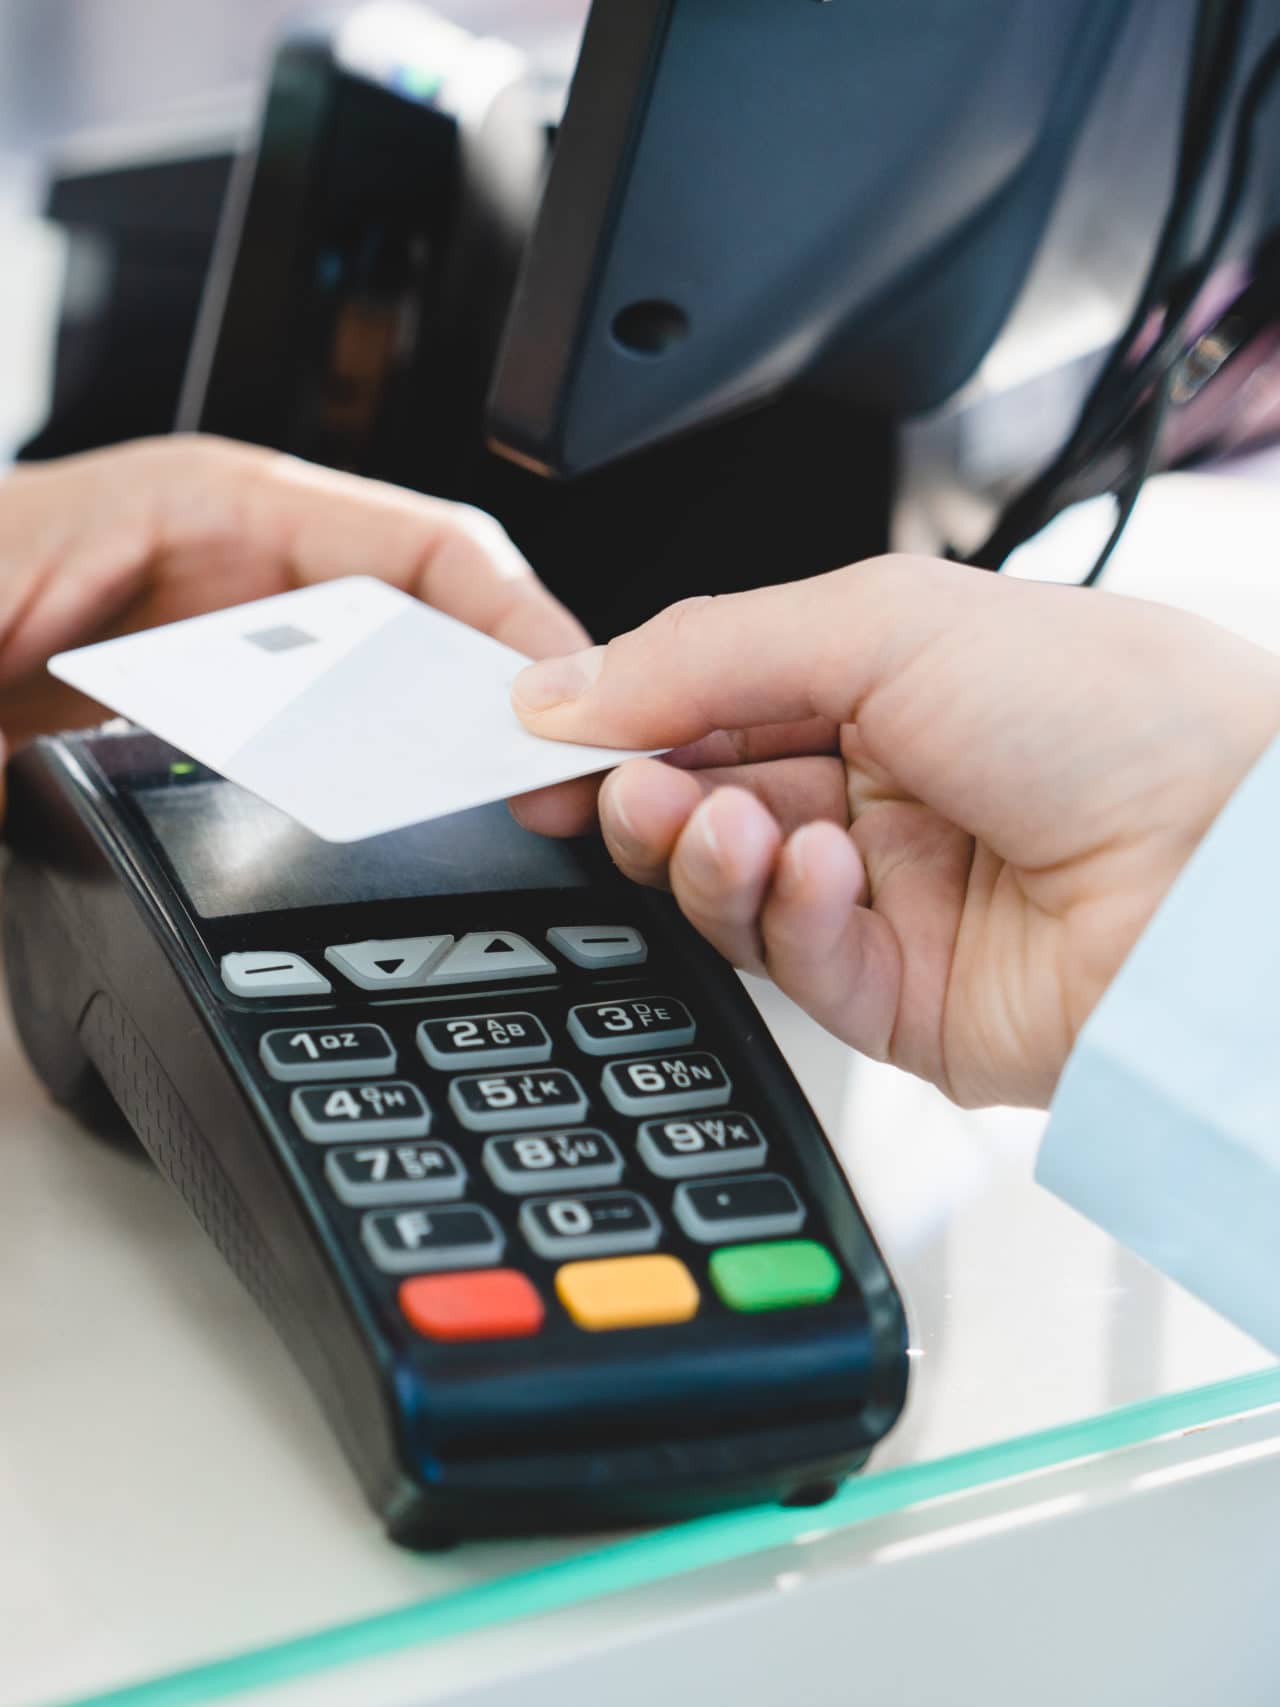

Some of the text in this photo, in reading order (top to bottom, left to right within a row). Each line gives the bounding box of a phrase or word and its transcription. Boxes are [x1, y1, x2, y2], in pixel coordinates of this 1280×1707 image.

[597, 1003, 671, 1031] 3 DEF
[288, 1032, 360, 1059] 1 QZ
[446, 1019, 526, 1047] 2 ABC
[627, 1060, 712, 1092] 6 MNO
[324, 1090, 361, 1119] 4
[477, 1079, 517, 1108] 5
[663, 1123, 705, 1152] 9
[354, 1149, 389, 1181] 7
[513, 1137, 556, 1169] 8
[396, 1213, 433, 1248] F
[547, 1200, 593, 1236] 0
